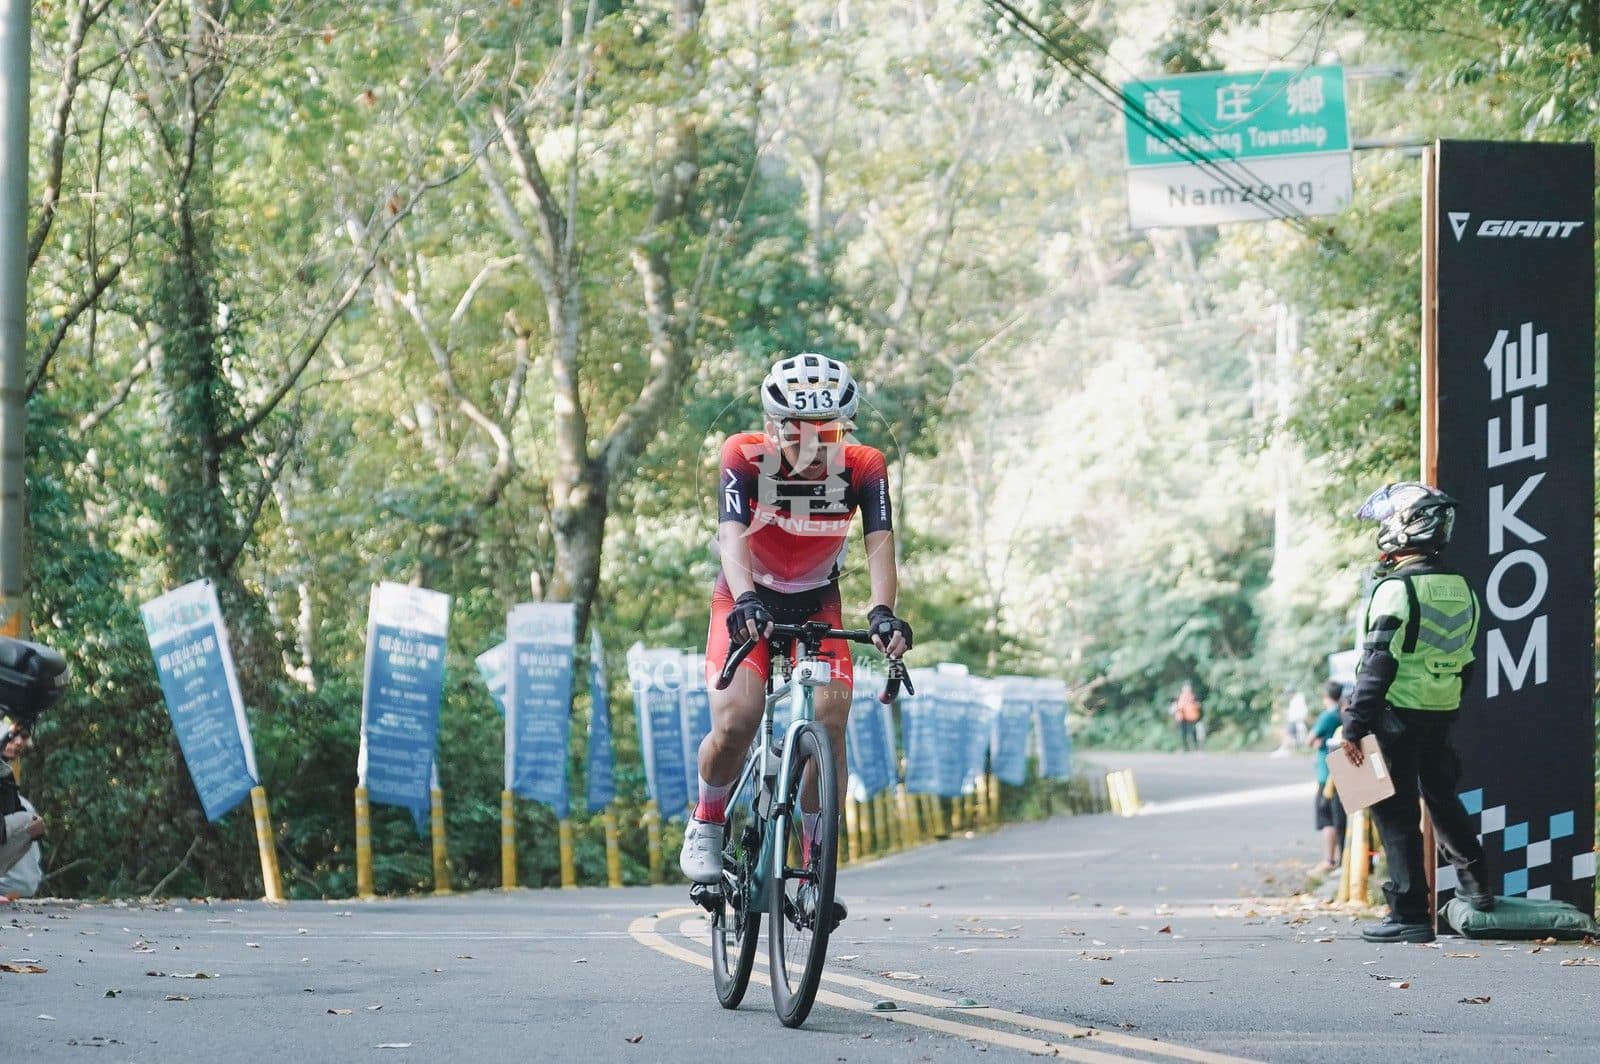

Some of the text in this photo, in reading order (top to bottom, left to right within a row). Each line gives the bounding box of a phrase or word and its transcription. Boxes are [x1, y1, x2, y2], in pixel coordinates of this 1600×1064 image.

[1143, 75, 1324, 125] 南庄鄉
[1247, 125, 1328, 148] Township
[1167, 180, 1313, 208] Namzong
[1476, 219, 1585, 238] GIANT
[794, 390, 834, 411] 513
